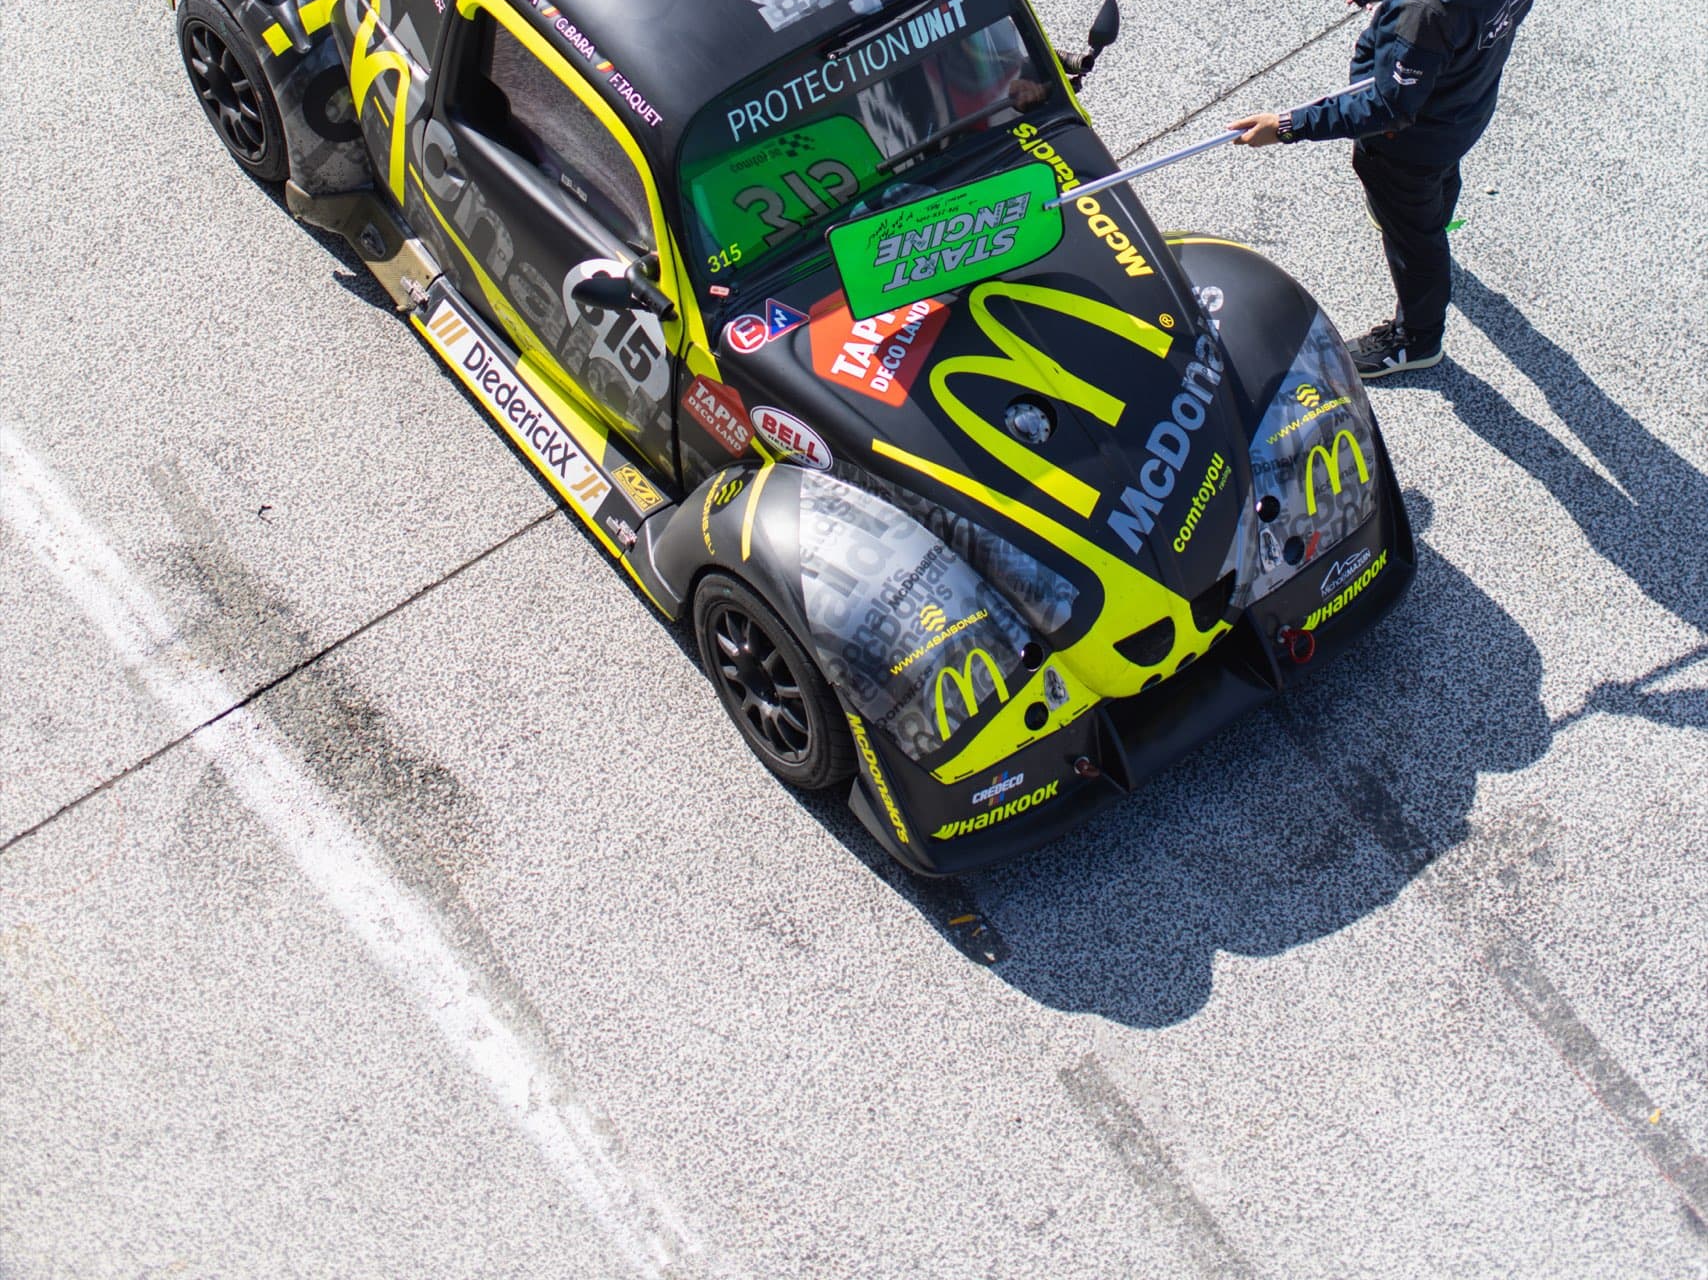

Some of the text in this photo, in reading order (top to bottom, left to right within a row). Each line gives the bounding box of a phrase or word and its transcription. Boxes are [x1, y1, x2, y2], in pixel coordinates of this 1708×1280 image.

[554, 16, 597, 63] G.BARA
[606, 72, 665, 129] F.TAQUET
[726, 24, 911, 143] PROTECTION
[707, 242, 743, 274] 315
[873, 191, 1033, 267] ENGINE
[881, 226, 1020, 294] START
[869, 300, 931, 393] DECO LAND
[687, 396, 743, 453] DECO LAND
[696, 381, 750, 444] TAPIS
[761, 413, 822, 465] BELL
[1172, 451, 1226, 554] comtoyou
[846, 711, 910, 846] McDonald's
[971, 772, 1025, 806] CREDECO
